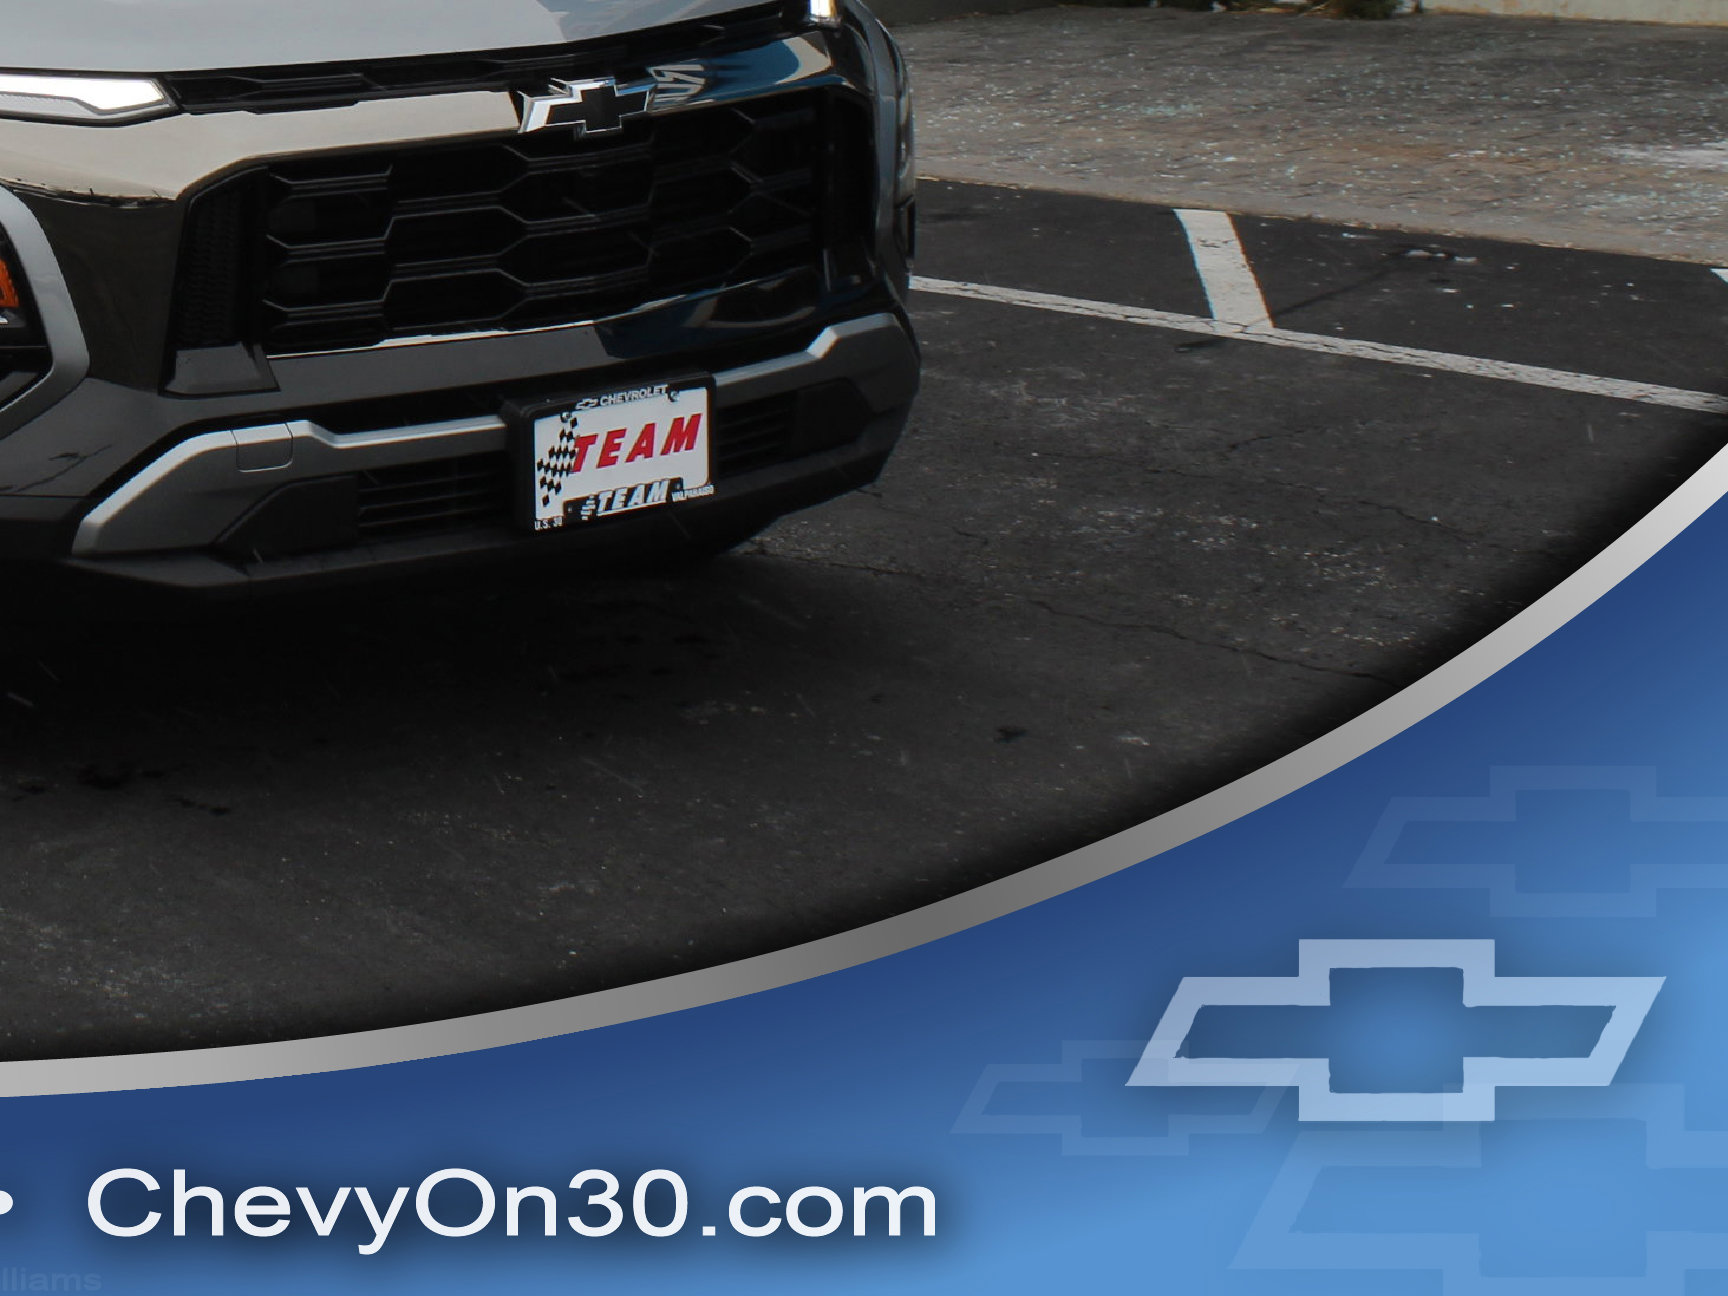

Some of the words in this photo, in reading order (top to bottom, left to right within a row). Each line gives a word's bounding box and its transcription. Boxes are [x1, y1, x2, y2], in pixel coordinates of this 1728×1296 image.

[599, 384, 668, 406] CHEVROLET
[571, 413, 704, 473] TEAM
[595, 479, 668, 513] TEAM
